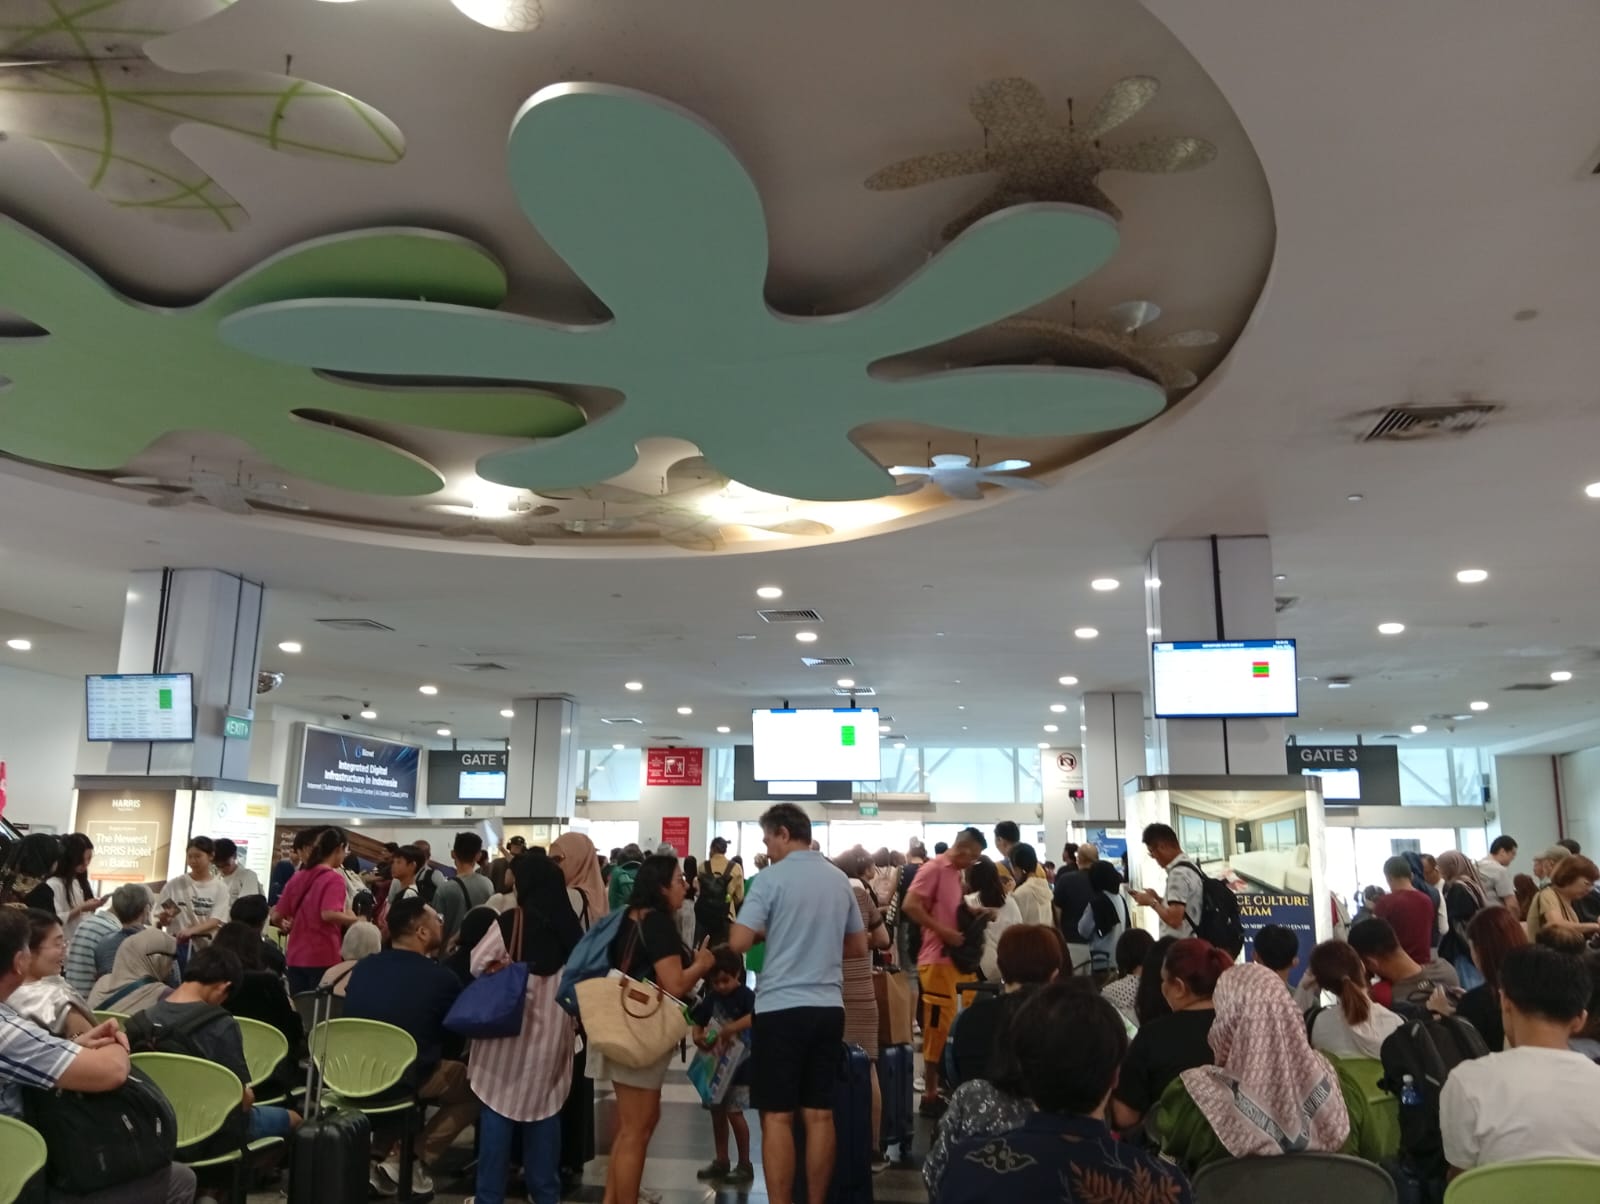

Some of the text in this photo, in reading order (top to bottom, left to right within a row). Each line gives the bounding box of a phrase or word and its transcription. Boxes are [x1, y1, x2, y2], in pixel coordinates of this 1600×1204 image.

[230, 721, 246, 736] EXIT
[461, 753, 507, 766] GATE 1
[1300, 748, 1359, 762] GATE 3
[338, 760, 388, 776] Integrated Digital
[324, 769, 398, 788] Infrastructure in Indonesia
[112, 799, 141, 808] HARRIS
[96, 833, 147, 845] The Newest
[127, 846, 152, 857] Hotel
[109, 859, 139, 869] Batam
[1253, 895, 1309, 906] CULTURE
[1240, 906, 1272, 917] ATAM
